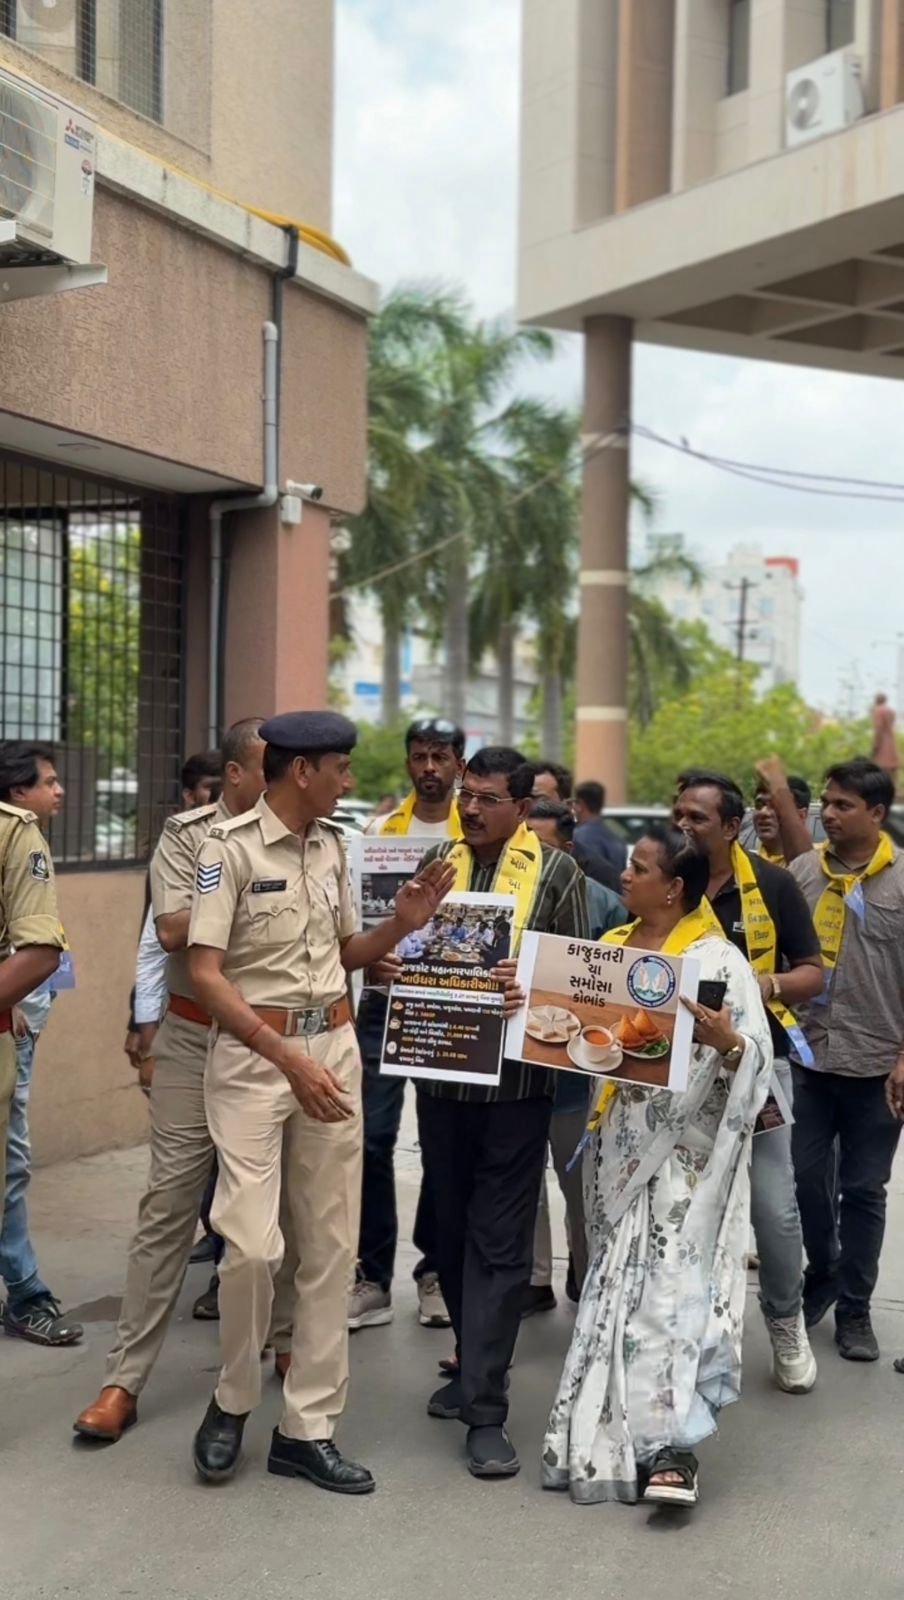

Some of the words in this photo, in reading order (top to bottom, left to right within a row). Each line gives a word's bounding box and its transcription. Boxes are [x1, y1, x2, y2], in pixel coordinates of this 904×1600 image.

[567, 943, 624, 964] કાજુકતરી
[431, 965, 492, 978] મહાનગરપાલિકા
[587, 963, 601, 976] ચા
[569, 973, 613, 994] સમોસા
[572, 991, 606, 1008] કોભાંડ
